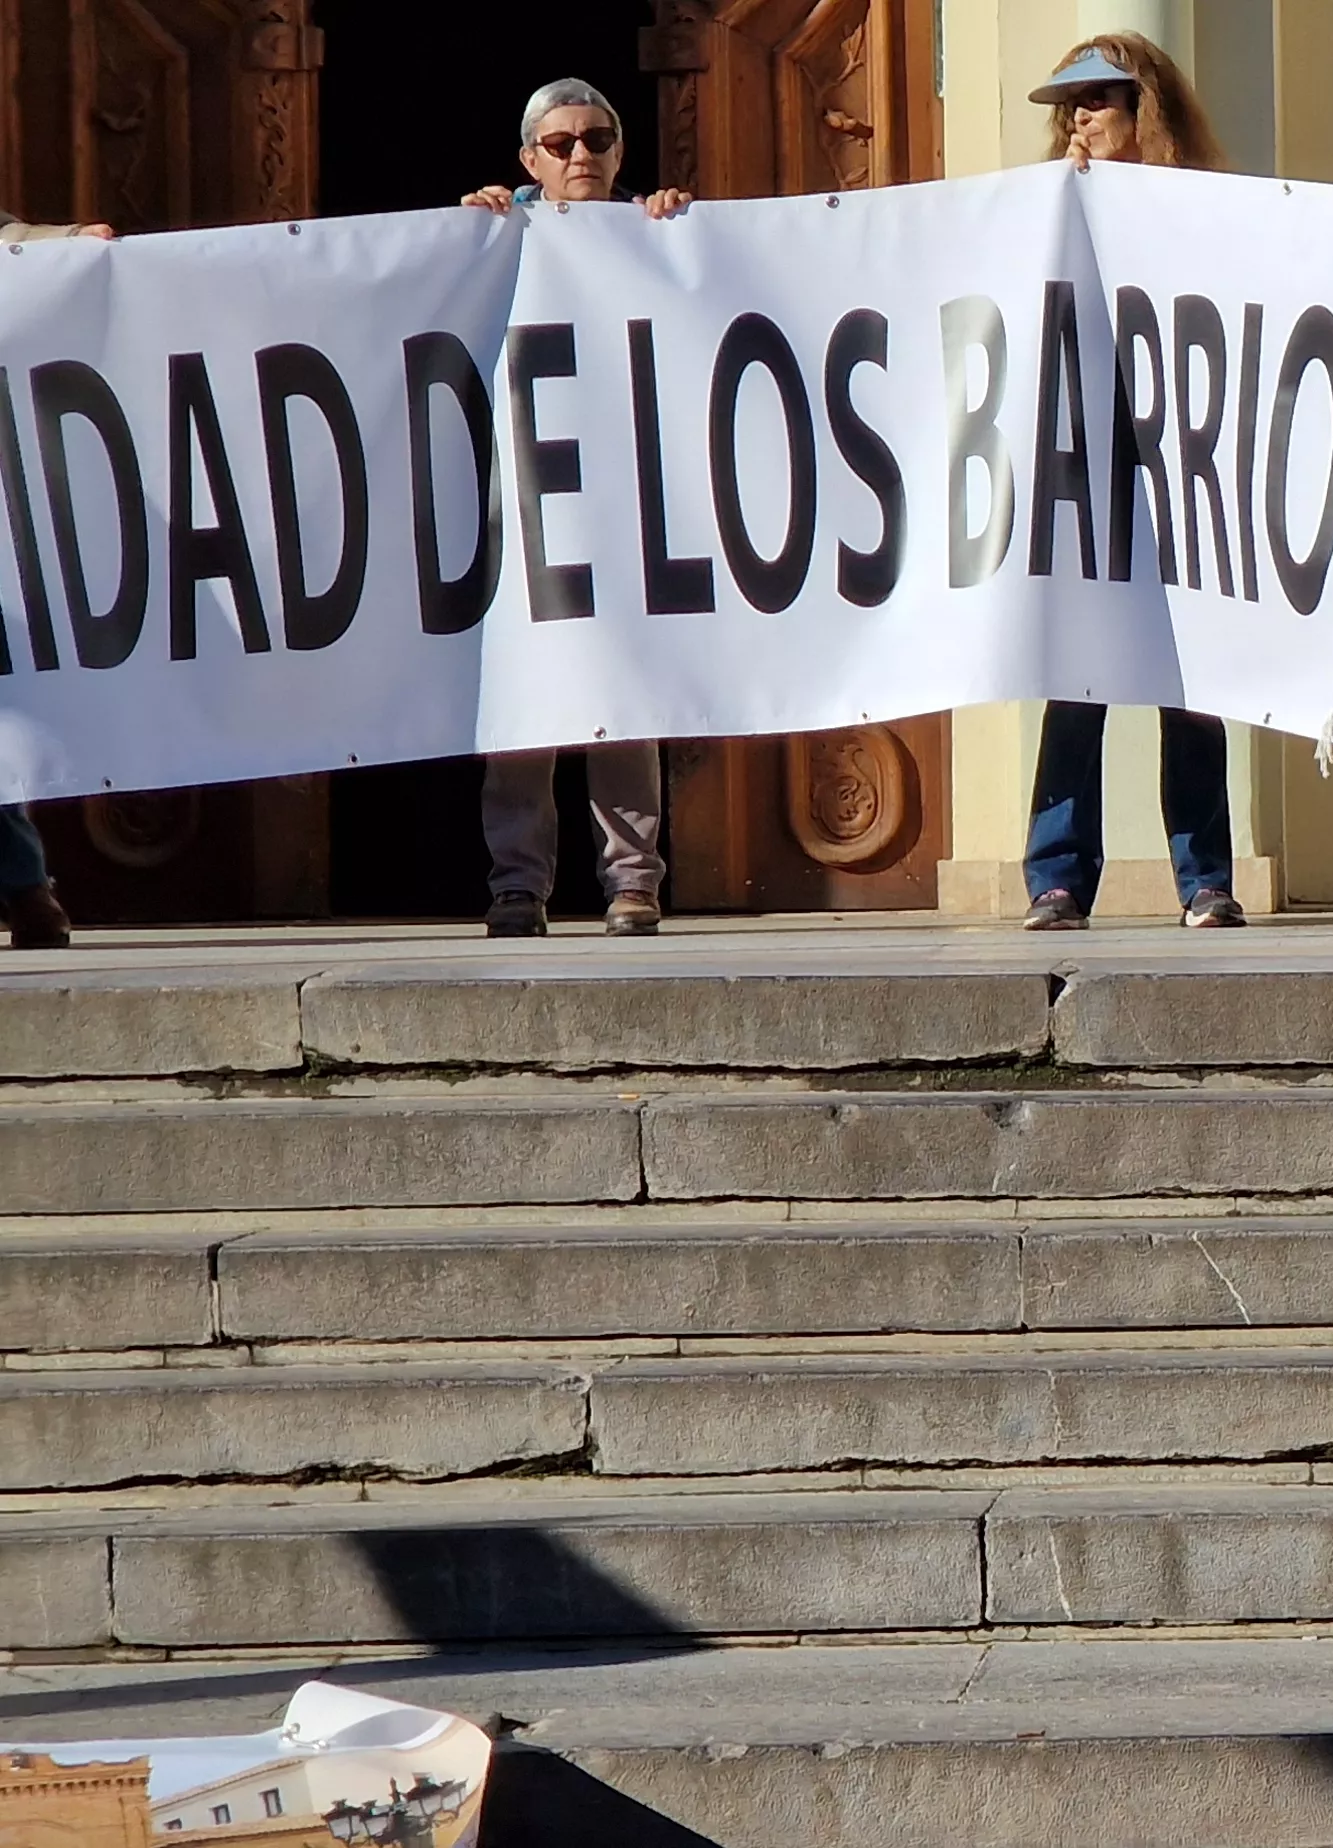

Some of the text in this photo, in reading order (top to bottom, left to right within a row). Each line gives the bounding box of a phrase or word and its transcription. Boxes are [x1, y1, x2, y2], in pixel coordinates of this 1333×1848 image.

[0, 340, 369, 676] IDAD
[402, 322, 596, 636] DE
[626, 306, 907, 617] LOS
